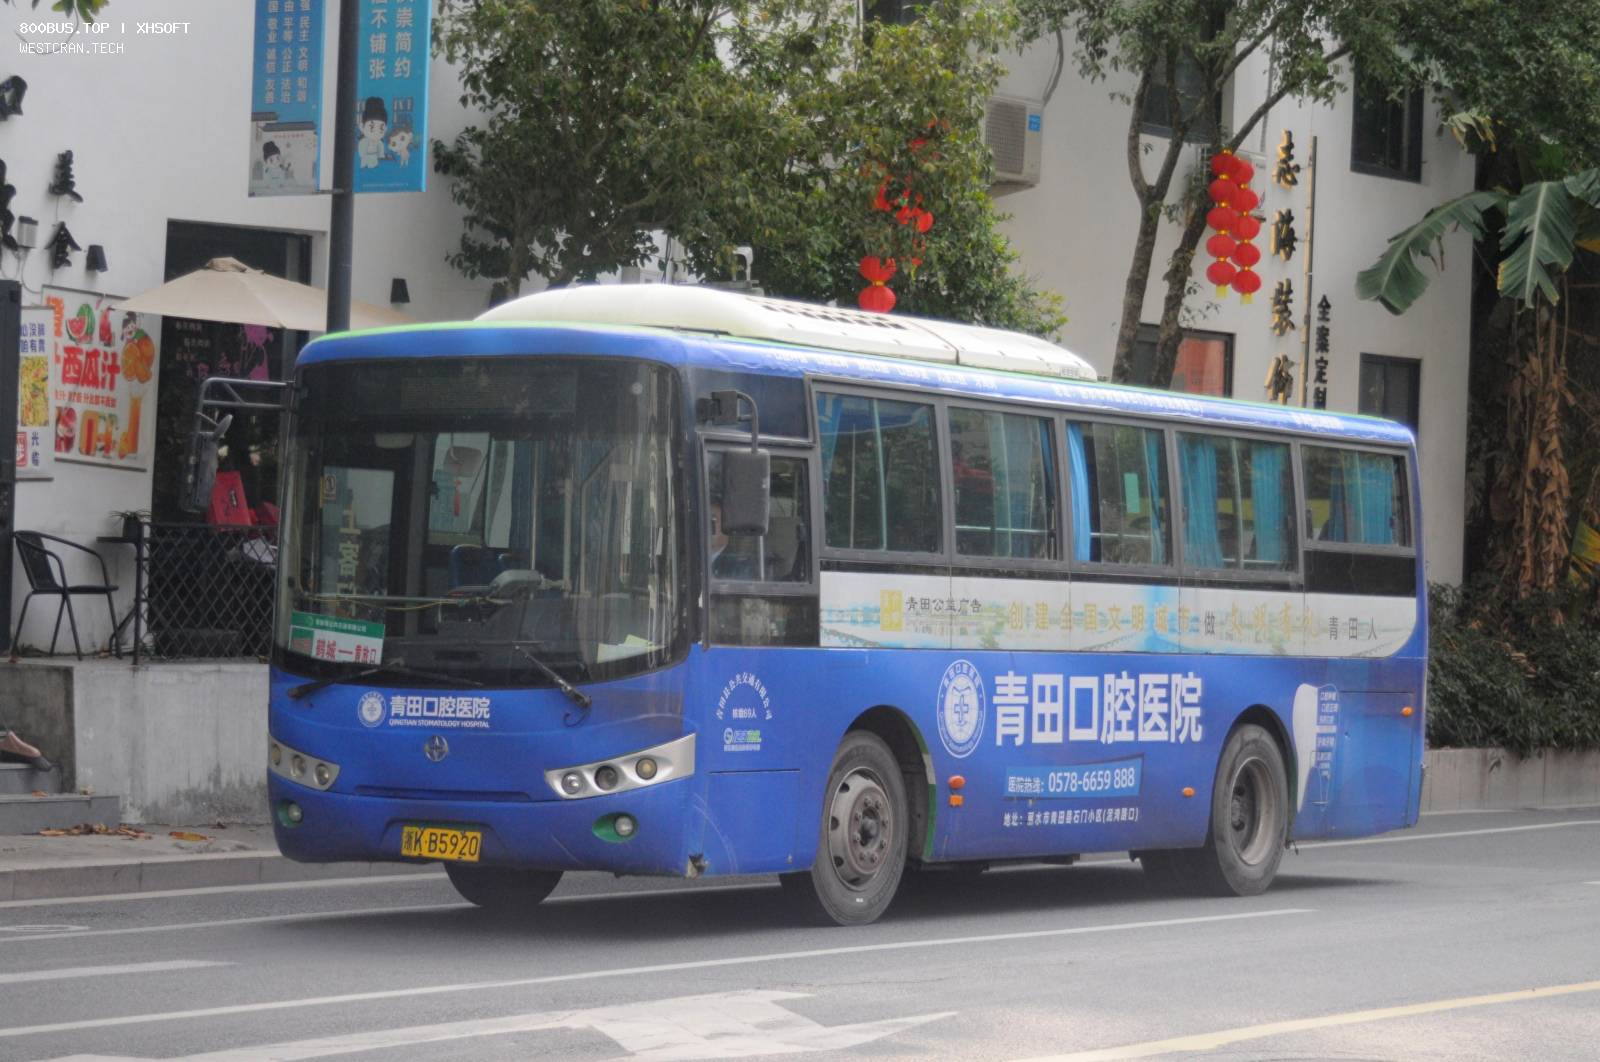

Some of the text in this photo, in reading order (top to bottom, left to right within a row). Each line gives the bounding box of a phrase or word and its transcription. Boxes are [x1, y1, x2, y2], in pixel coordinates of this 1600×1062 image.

[369, 0, 388, 79] 不铺张
[394, 0, 413, 78] 崇简约
[61, 345, 121, 392] 西瓜汁
[905, 596, 982, 614] 青田公益广告
[1008, 602, 1191, 634] 创建全国文明城市
[1204, 611, 1216, 636] 做
[1328, 616, 1378, 640] 青田人
[388, 718, 490, 728] QINGTIAN STOMATOLOGY HOSPITAL
[390, 695, 491, 719] 青田口腔医院
[992, 670, 1203, 746] 青田口腔医院
[1048, 770, 1111, 793] 0578-6659
[1113, 767, 1135, 788] 888
